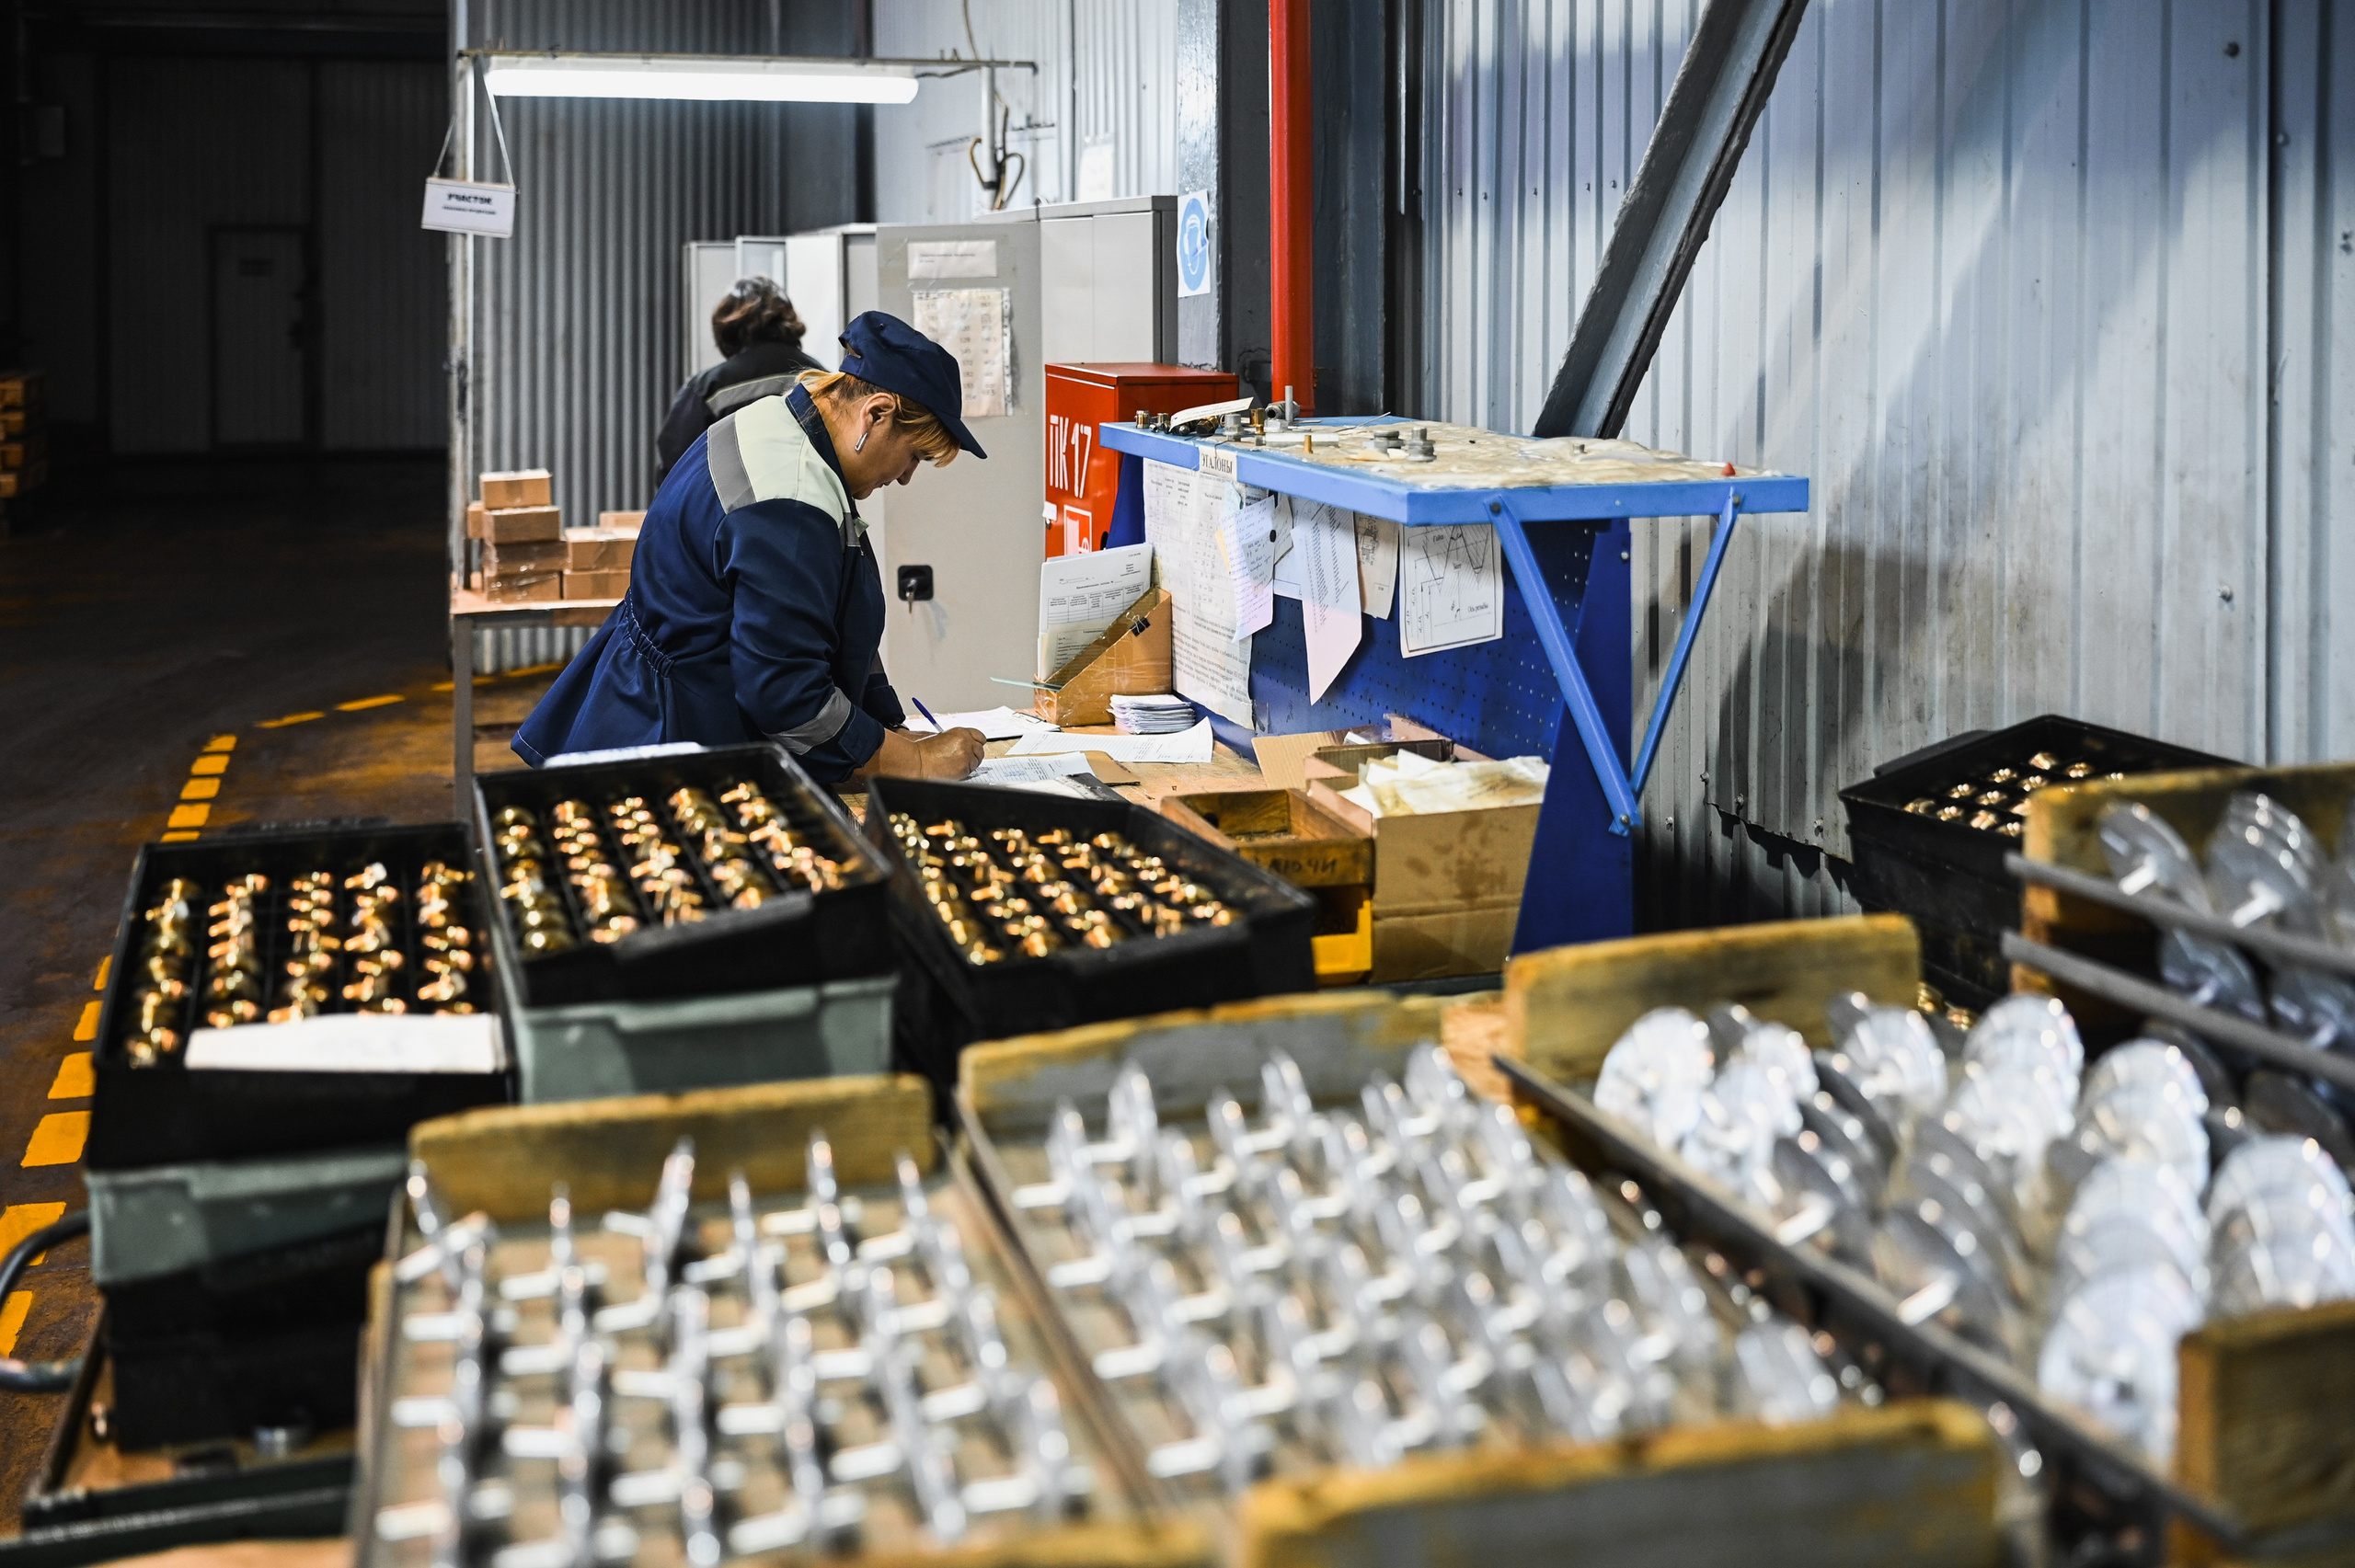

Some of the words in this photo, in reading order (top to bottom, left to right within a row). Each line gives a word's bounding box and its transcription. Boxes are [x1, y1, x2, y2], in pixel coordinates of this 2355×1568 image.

[1050, 414, 1069, 491] ПК
[1071, 422, 1092, 498] 17
[1201, 452, 1233, 474] ЭТАЛОНЫ
[1255, 856, 1337, 875] ЛЮЧИ
